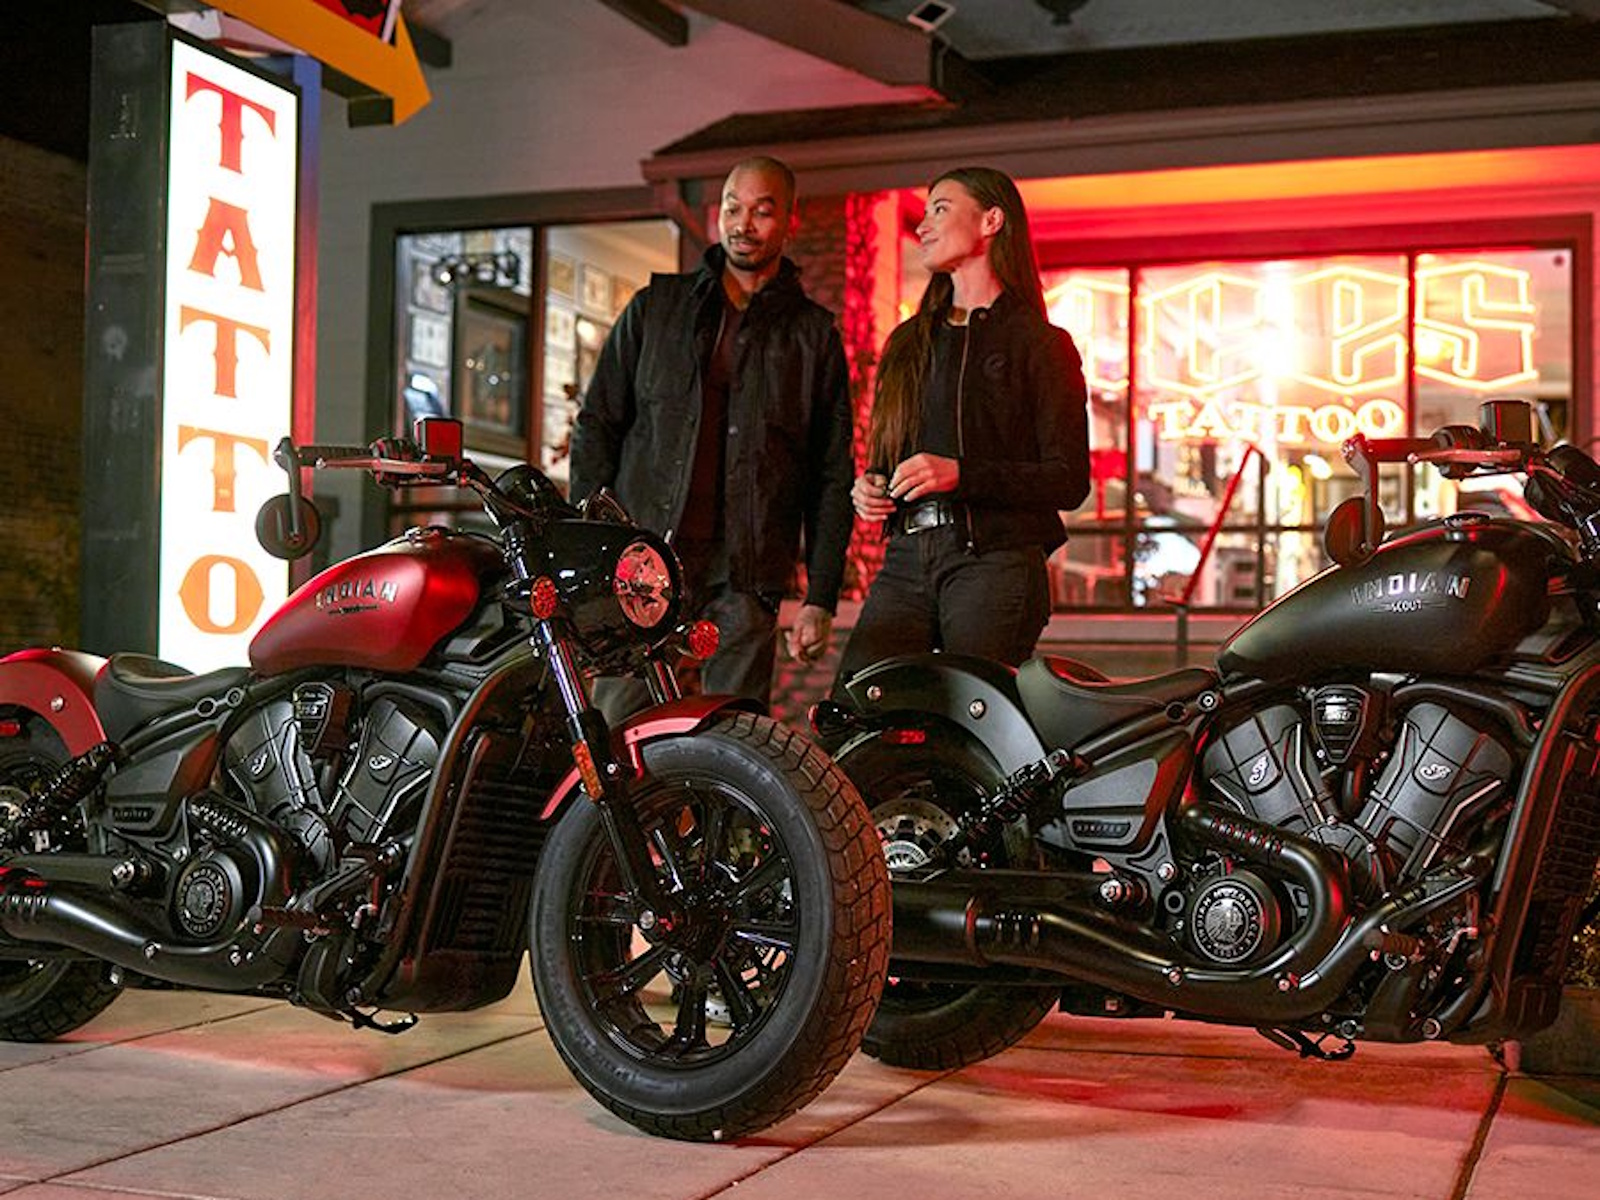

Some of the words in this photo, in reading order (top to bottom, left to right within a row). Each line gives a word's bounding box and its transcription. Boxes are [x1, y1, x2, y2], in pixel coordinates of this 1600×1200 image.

[1149, 398, 1405, 442] TATTOO
[315, 578, 399, 610] INDIAN
[1350, 572, 1471, 606] INDIAN
[1390, 600, 1423, 613] SCOUT
